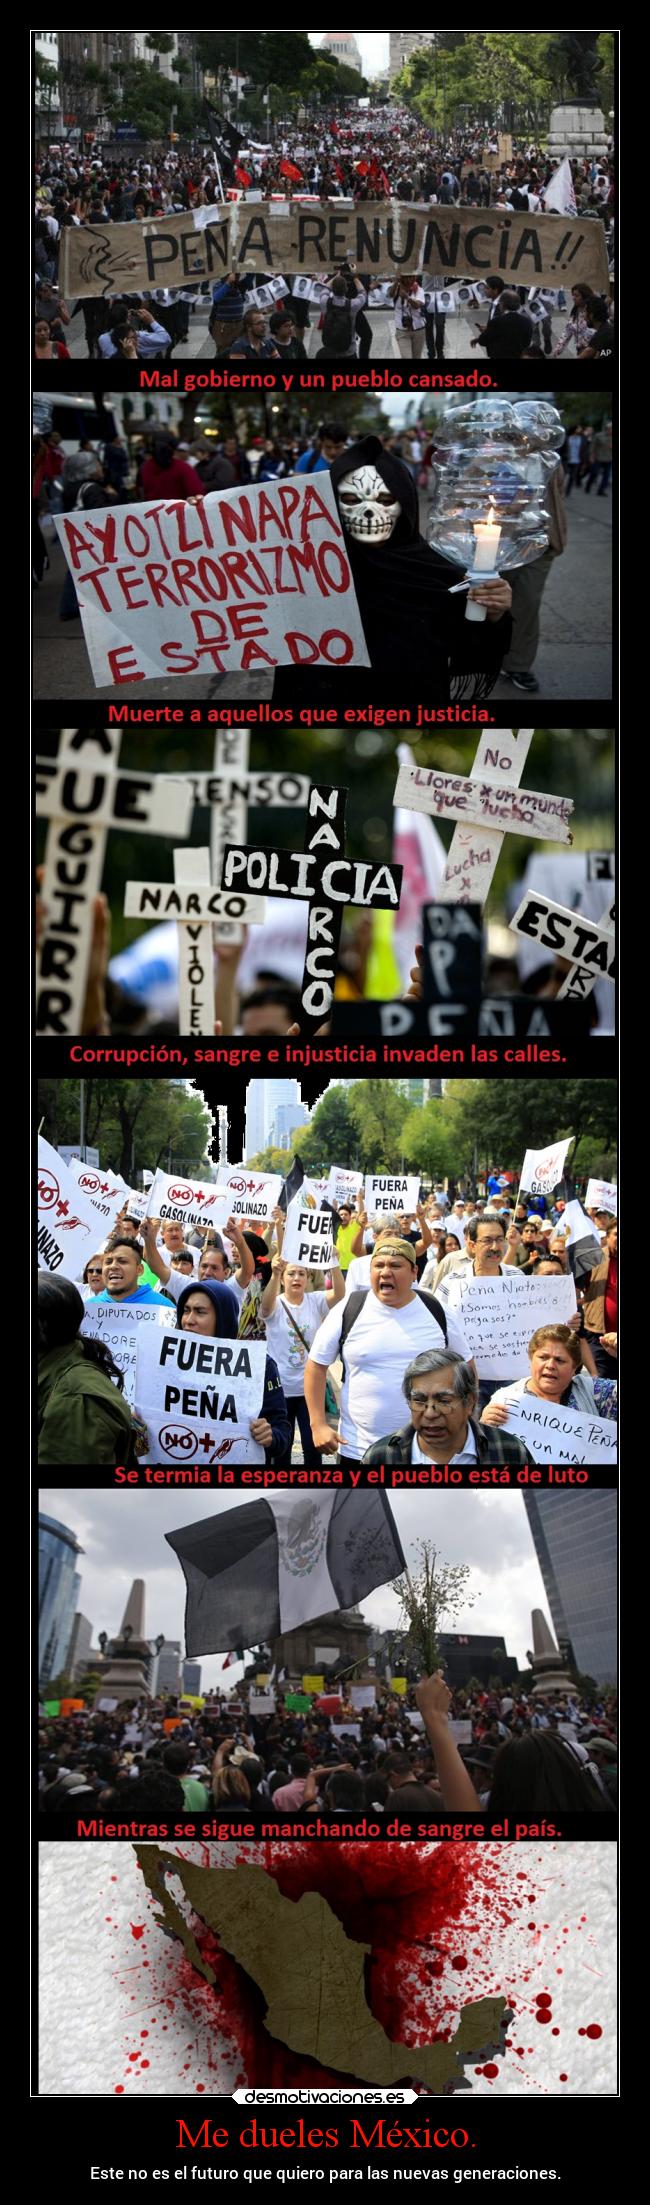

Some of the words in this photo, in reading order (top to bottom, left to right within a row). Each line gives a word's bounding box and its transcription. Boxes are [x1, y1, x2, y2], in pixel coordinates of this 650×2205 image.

[143, 217, 273, 282] PEÑA
[78, 540, 350, 612] TERRORIZMO
[190, 602, 269, 645] DE
[107, 629, 354, 685] ESTADO
[484, 748, 512, 770] No
[433, 788, 467, 812] que
[225, 850, 399, 905] POLICIA
[139, 888, 247, 918] NARCO
[186, 925, 205, 1036] VIOLE
[171, 1190, 190, 1199] NO
[230, 1182, 244, 1191] NO
[372, 1179, 408, 1192] FUERA
[375, 1196, 404, 1210] PEÑA
[97, 1307, 157, 1321] DIPUTADOS
[159, 1336, 252, 1378] FUERA
[165, 1385, 238, 1423] PEÑA
[504, 1398, 583, 1437] ENRIQUE
[165, 1433, 192, 1449] NO
